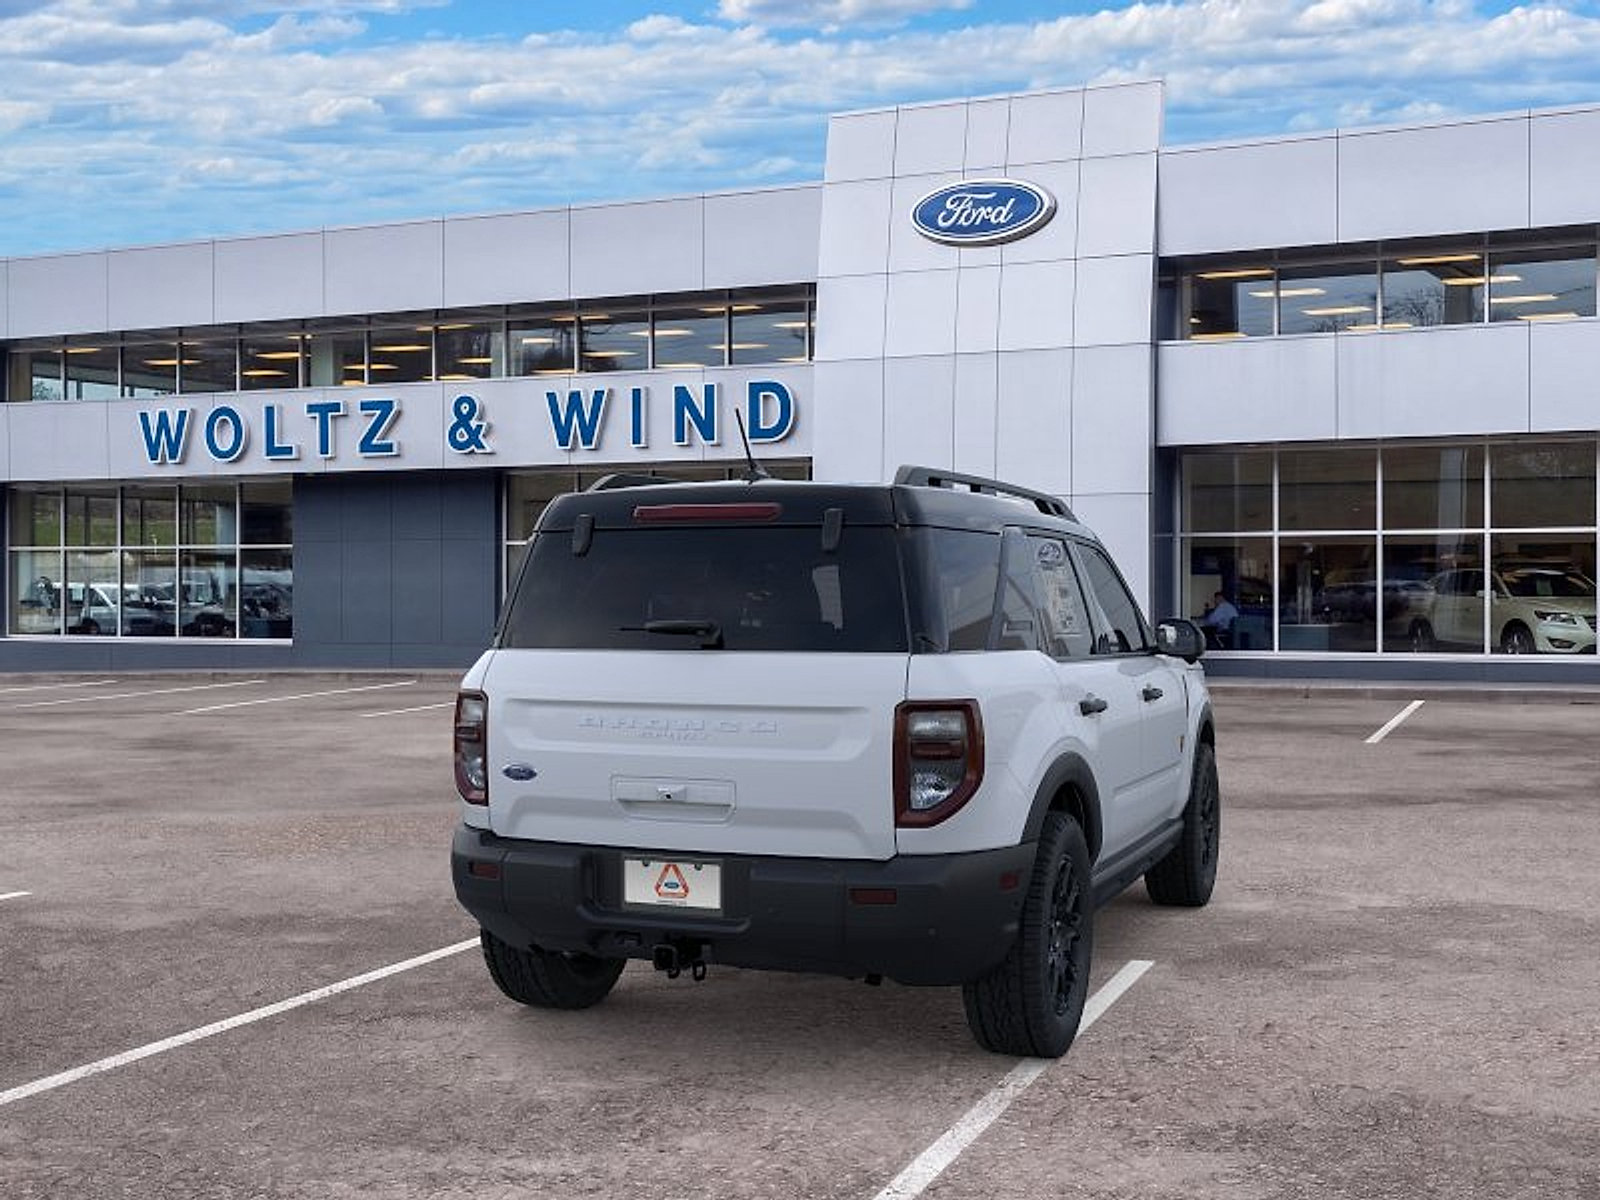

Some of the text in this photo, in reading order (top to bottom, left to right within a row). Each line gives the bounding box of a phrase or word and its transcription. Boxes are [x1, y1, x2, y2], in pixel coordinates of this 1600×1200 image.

[937, 191, 1016, 228] Ford
[138, 380, 795, 465] WOLTZ & WIND
